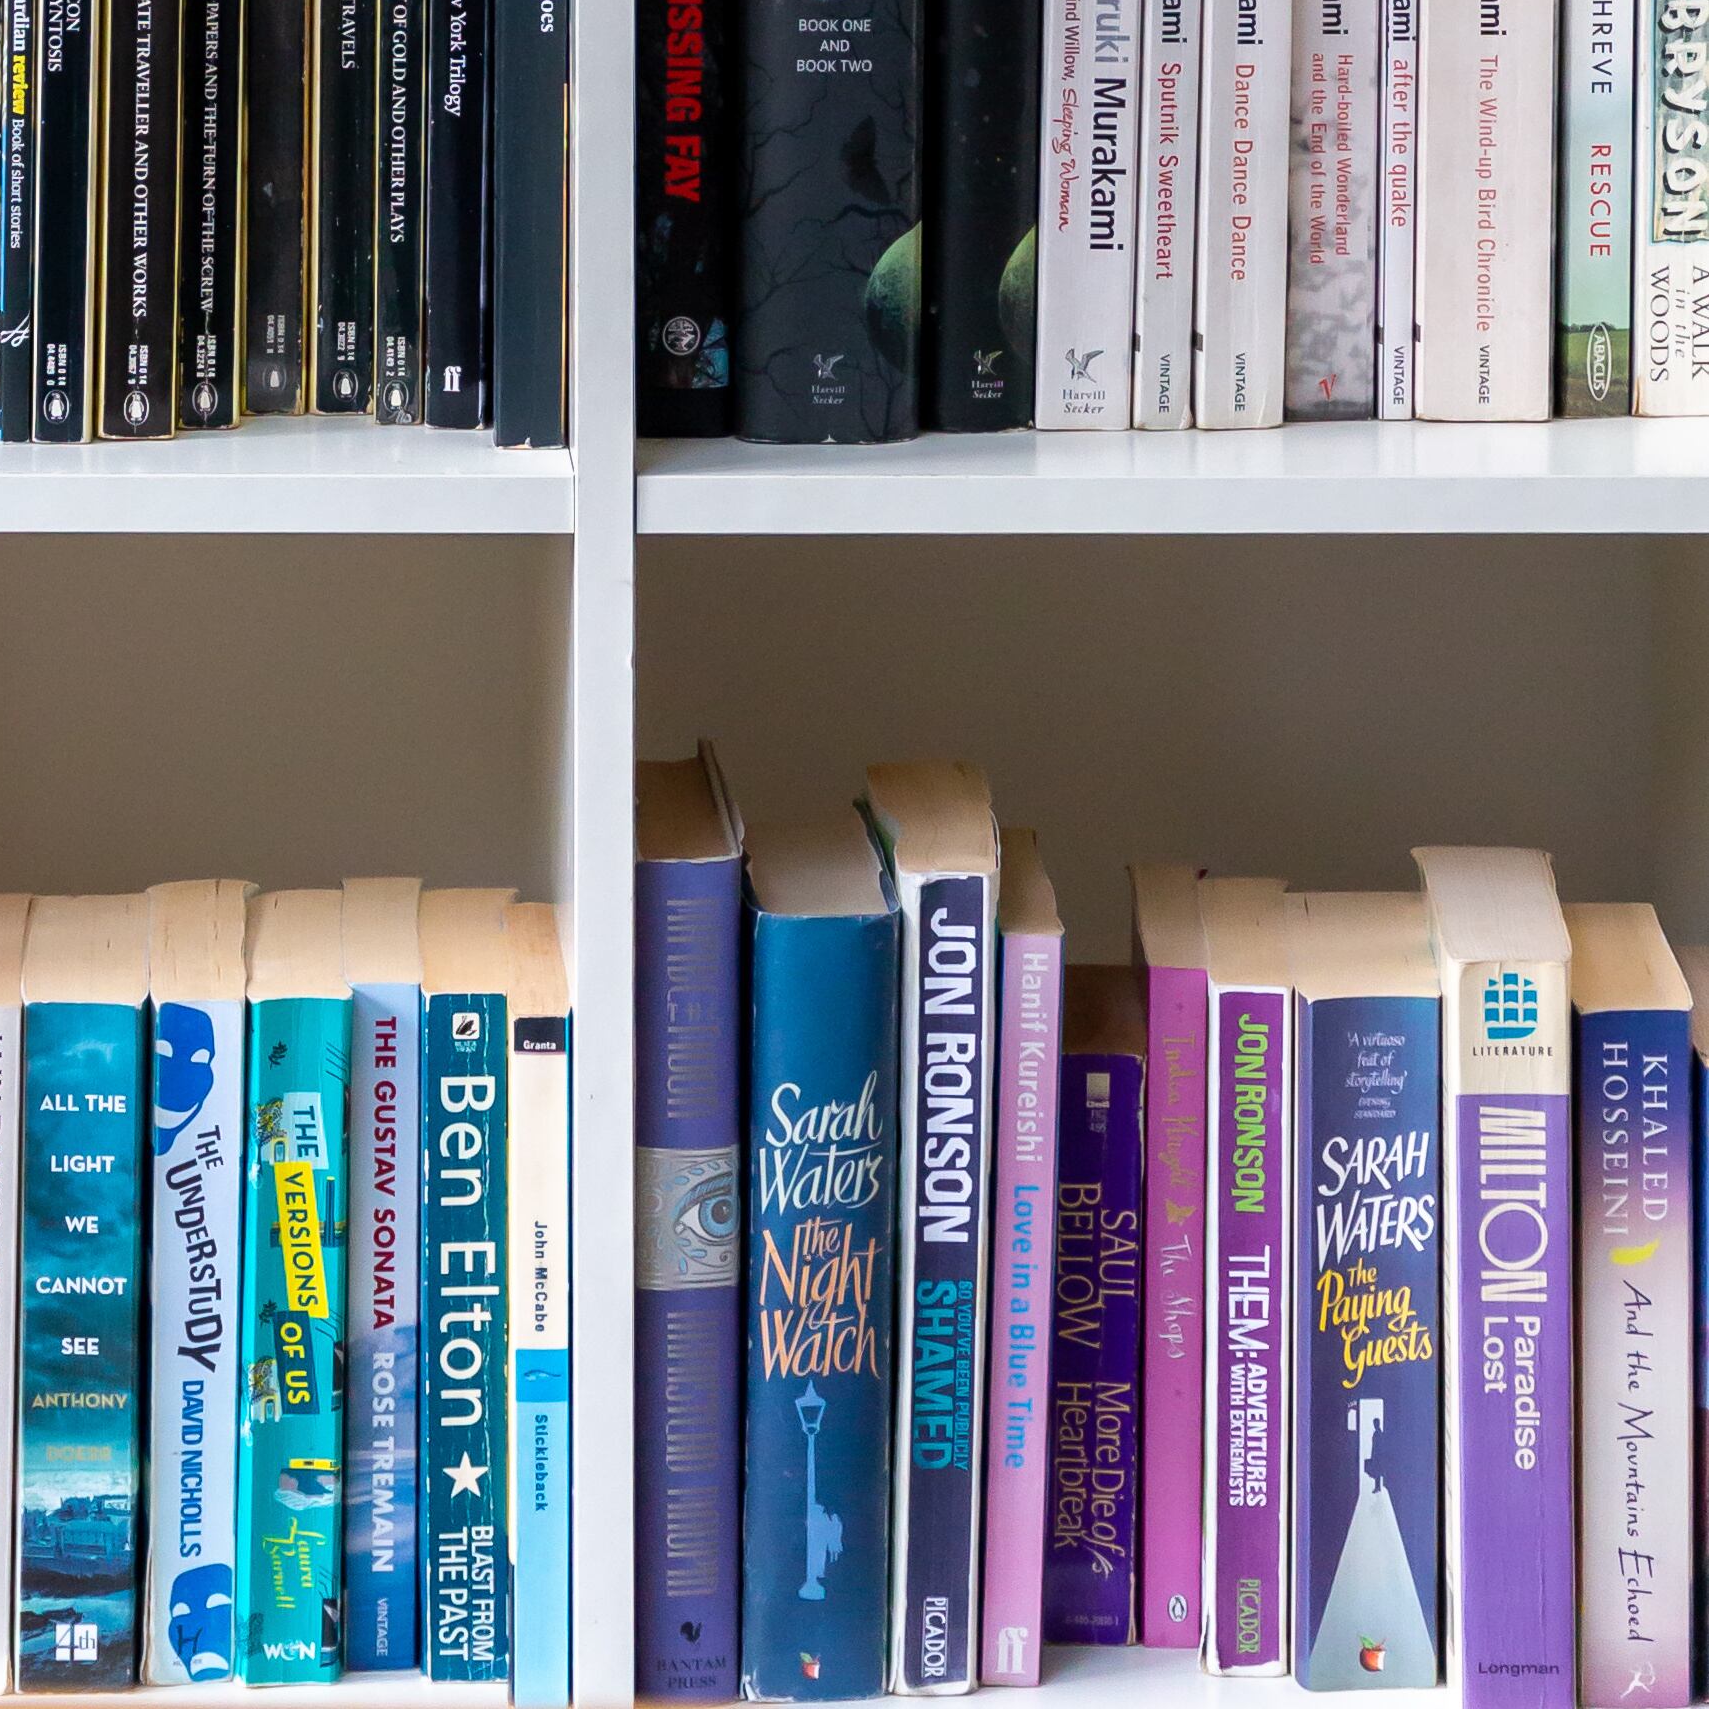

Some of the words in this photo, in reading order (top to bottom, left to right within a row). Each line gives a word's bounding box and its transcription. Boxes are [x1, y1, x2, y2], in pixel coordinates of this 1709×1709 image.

[449, 10, 466, 51] York
[444, 55, 466, 117] Trilogy
[1476, 55, 1498, 90] The
[1472, 97, 1498, 179] Wind-up
[1476, 189, 1497, 230] Bird
[1590, 144, 1611, 257] RESCUE
[1474, 236, 1496, 332] Chronicle
[1478, 344, 1490, 404] VINTAGE
[1020, 952, 1048, 1035] Hanif
[374, 1016, 396, 1068] THE
[1473, 1046, 1553, 1057] LITERATURE
[1016, 1042, 1047, 1162] Kureishi
[374, 1081, 396, 1196] GUSTAV
[1012, 1184, 1039, 1254] Love
[1479, 1107, 1548, 1303] MILTON
[373, 1208, 395, 1329] SONATA
[534, 1221, 550, 1260] John
[1011, 1261, 1038, 1289] in
[534, 1267, 549, 1333] McCabe
[1009, 1298, 1031, 1314] a
[373, 1352, 396, 1428] ROSE
[1008, 1324, 1035, 1388] Blue
[1483, 1316, 1509, 1394] Lost
[1513, 1315, 1539, 1470] Paradise
[534, 1414, 549, 1512] Stickleback
[1005, 1398, 1033, 1468] Time
[372, 1438, 395, 1573] TREMAIN
[377, 1597, 389, 1656] VINTAGE
[1477, 1661, 1559, 1676] Longman
